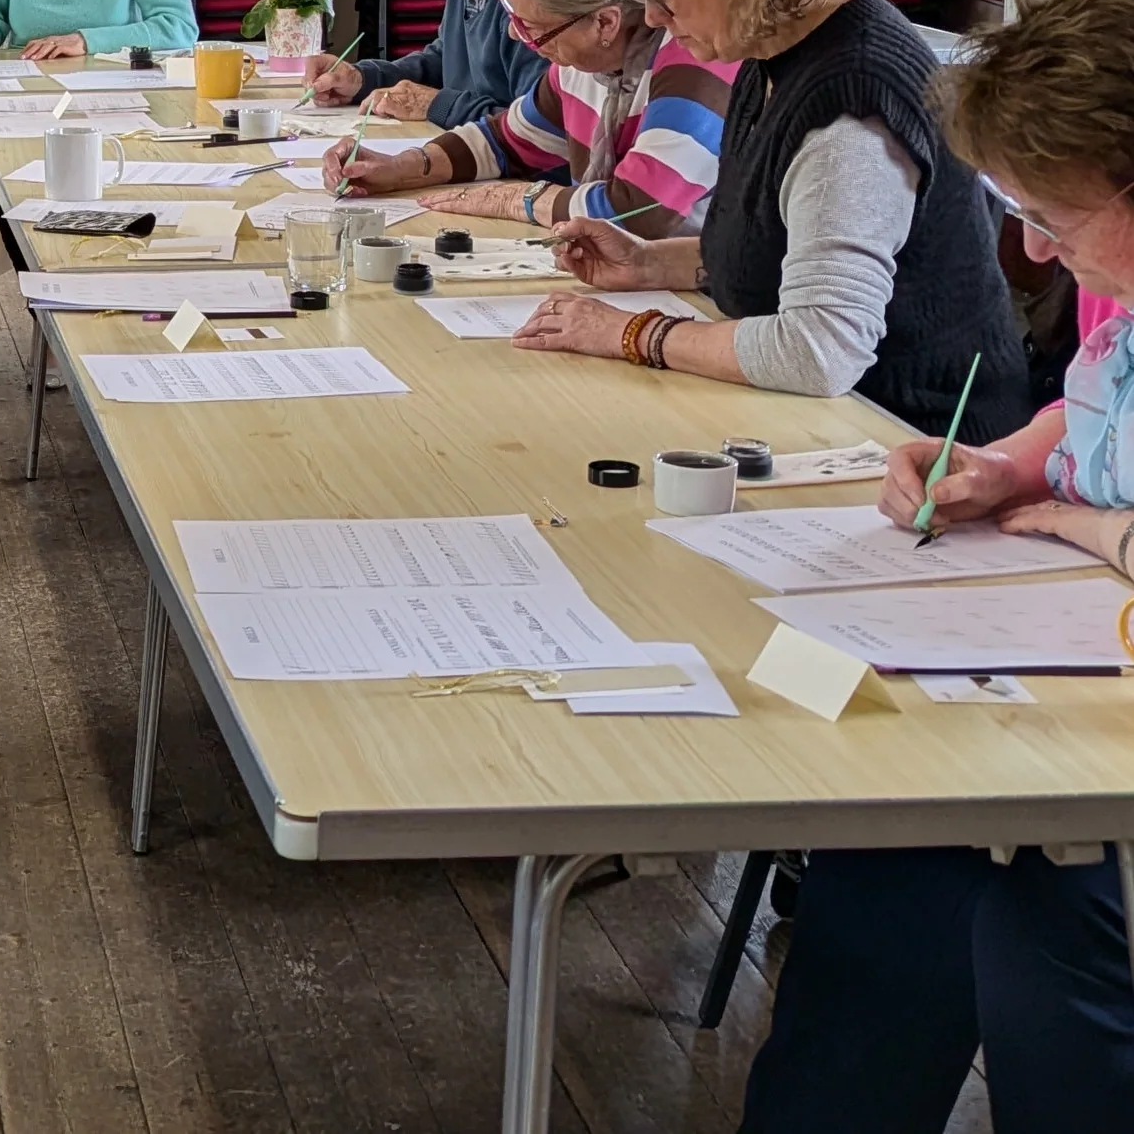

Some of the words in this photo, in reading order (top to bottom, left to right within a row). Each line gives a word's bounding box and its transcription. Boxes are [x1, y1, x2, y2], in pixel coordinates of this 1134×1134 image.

[366, 608, 386, 627] DRILLS
[242, 626, 261, 644] DRILLS
[376, 626, 408, 658] CONNECTING
